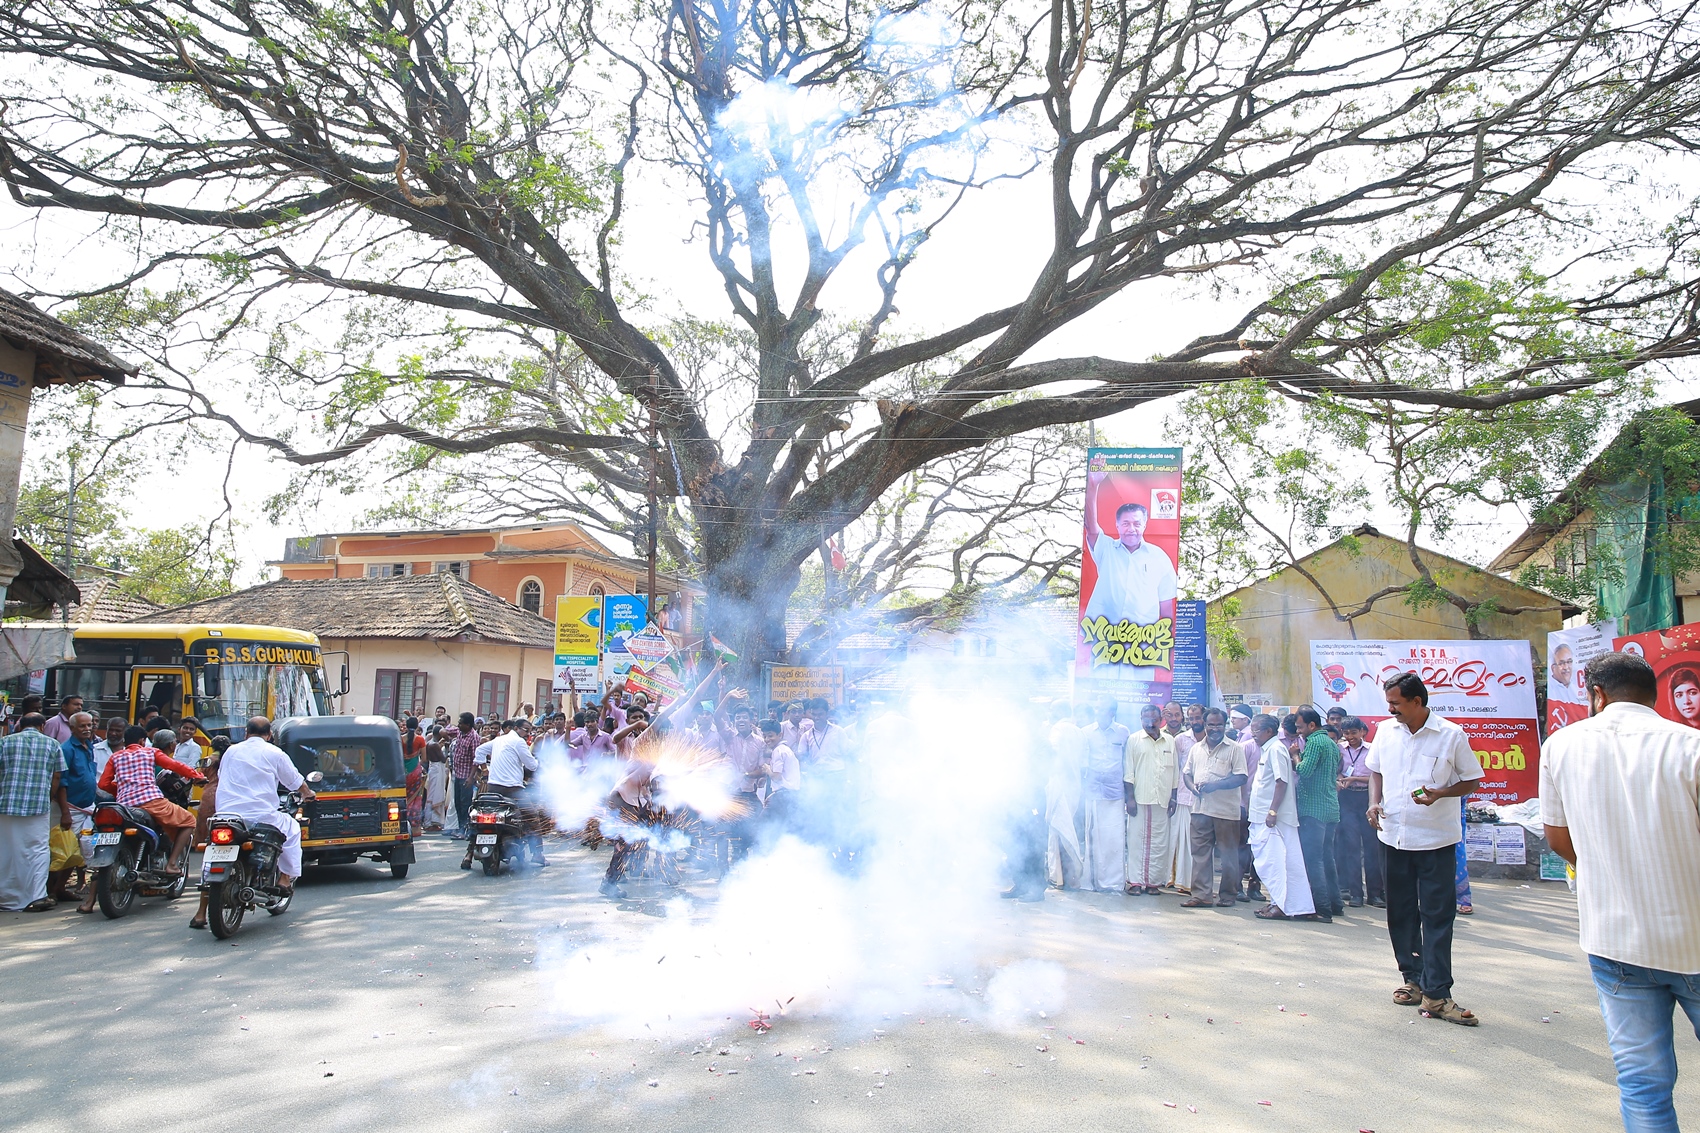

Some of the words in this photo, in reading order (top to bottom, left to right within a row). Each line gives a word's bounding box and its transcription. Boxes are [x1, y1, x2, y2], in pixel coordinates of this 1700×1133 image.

[1129, 462, 1154, 472] വിജയൻ
[1080, 615, 1175, 650] നവകേരള
[1472, 744, 1526, 771] നാർ
